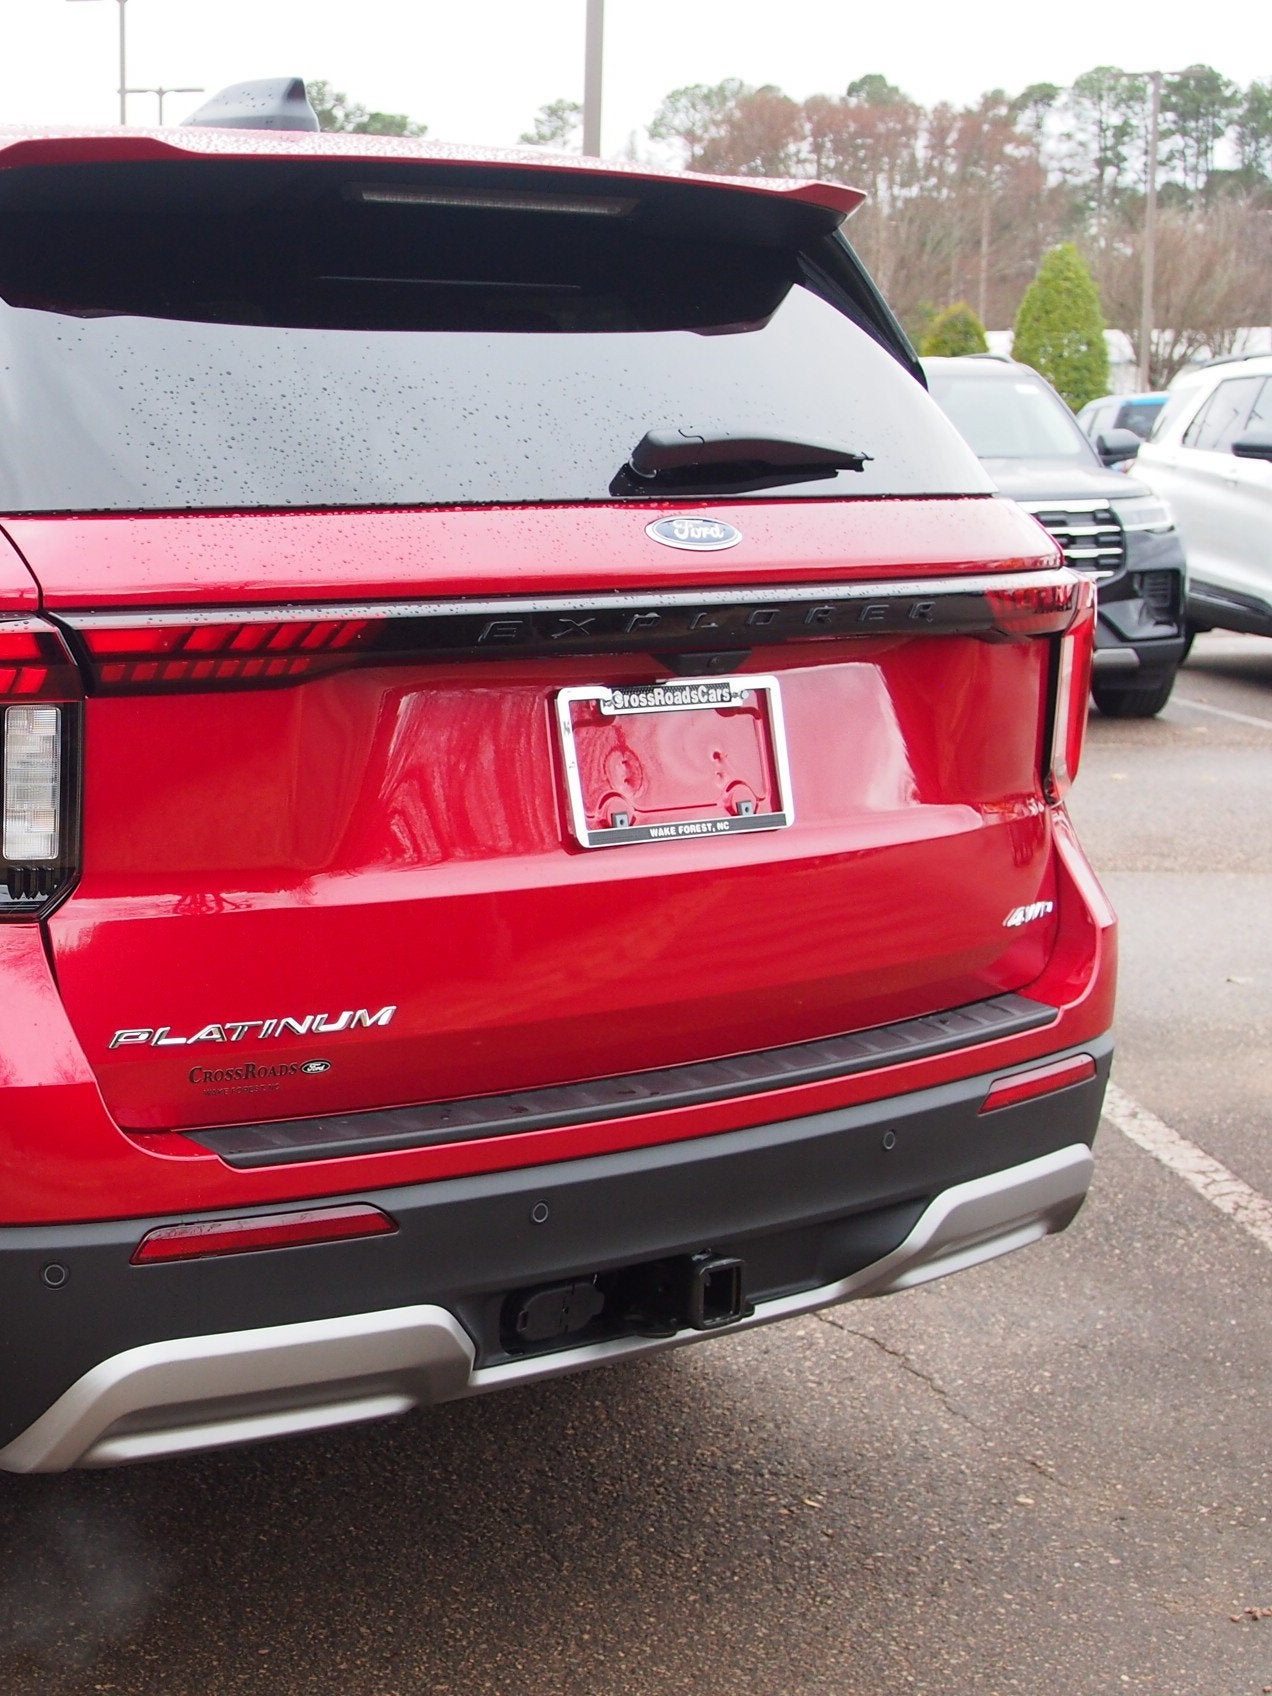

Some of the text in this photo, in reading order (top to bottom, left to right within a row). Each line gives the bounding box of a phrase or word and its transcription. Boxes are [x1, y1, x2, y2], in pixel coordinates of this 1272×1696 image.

[673, 519, 724, 540] Ford
[476, 600, 937, 643] EXPLORER
[613, 685, 730, 708] CrossRoadsCars
[649, 821, 730, 838] WAKE FOREST, NC
[108, 1005, 397, 1050] PLATINUM
